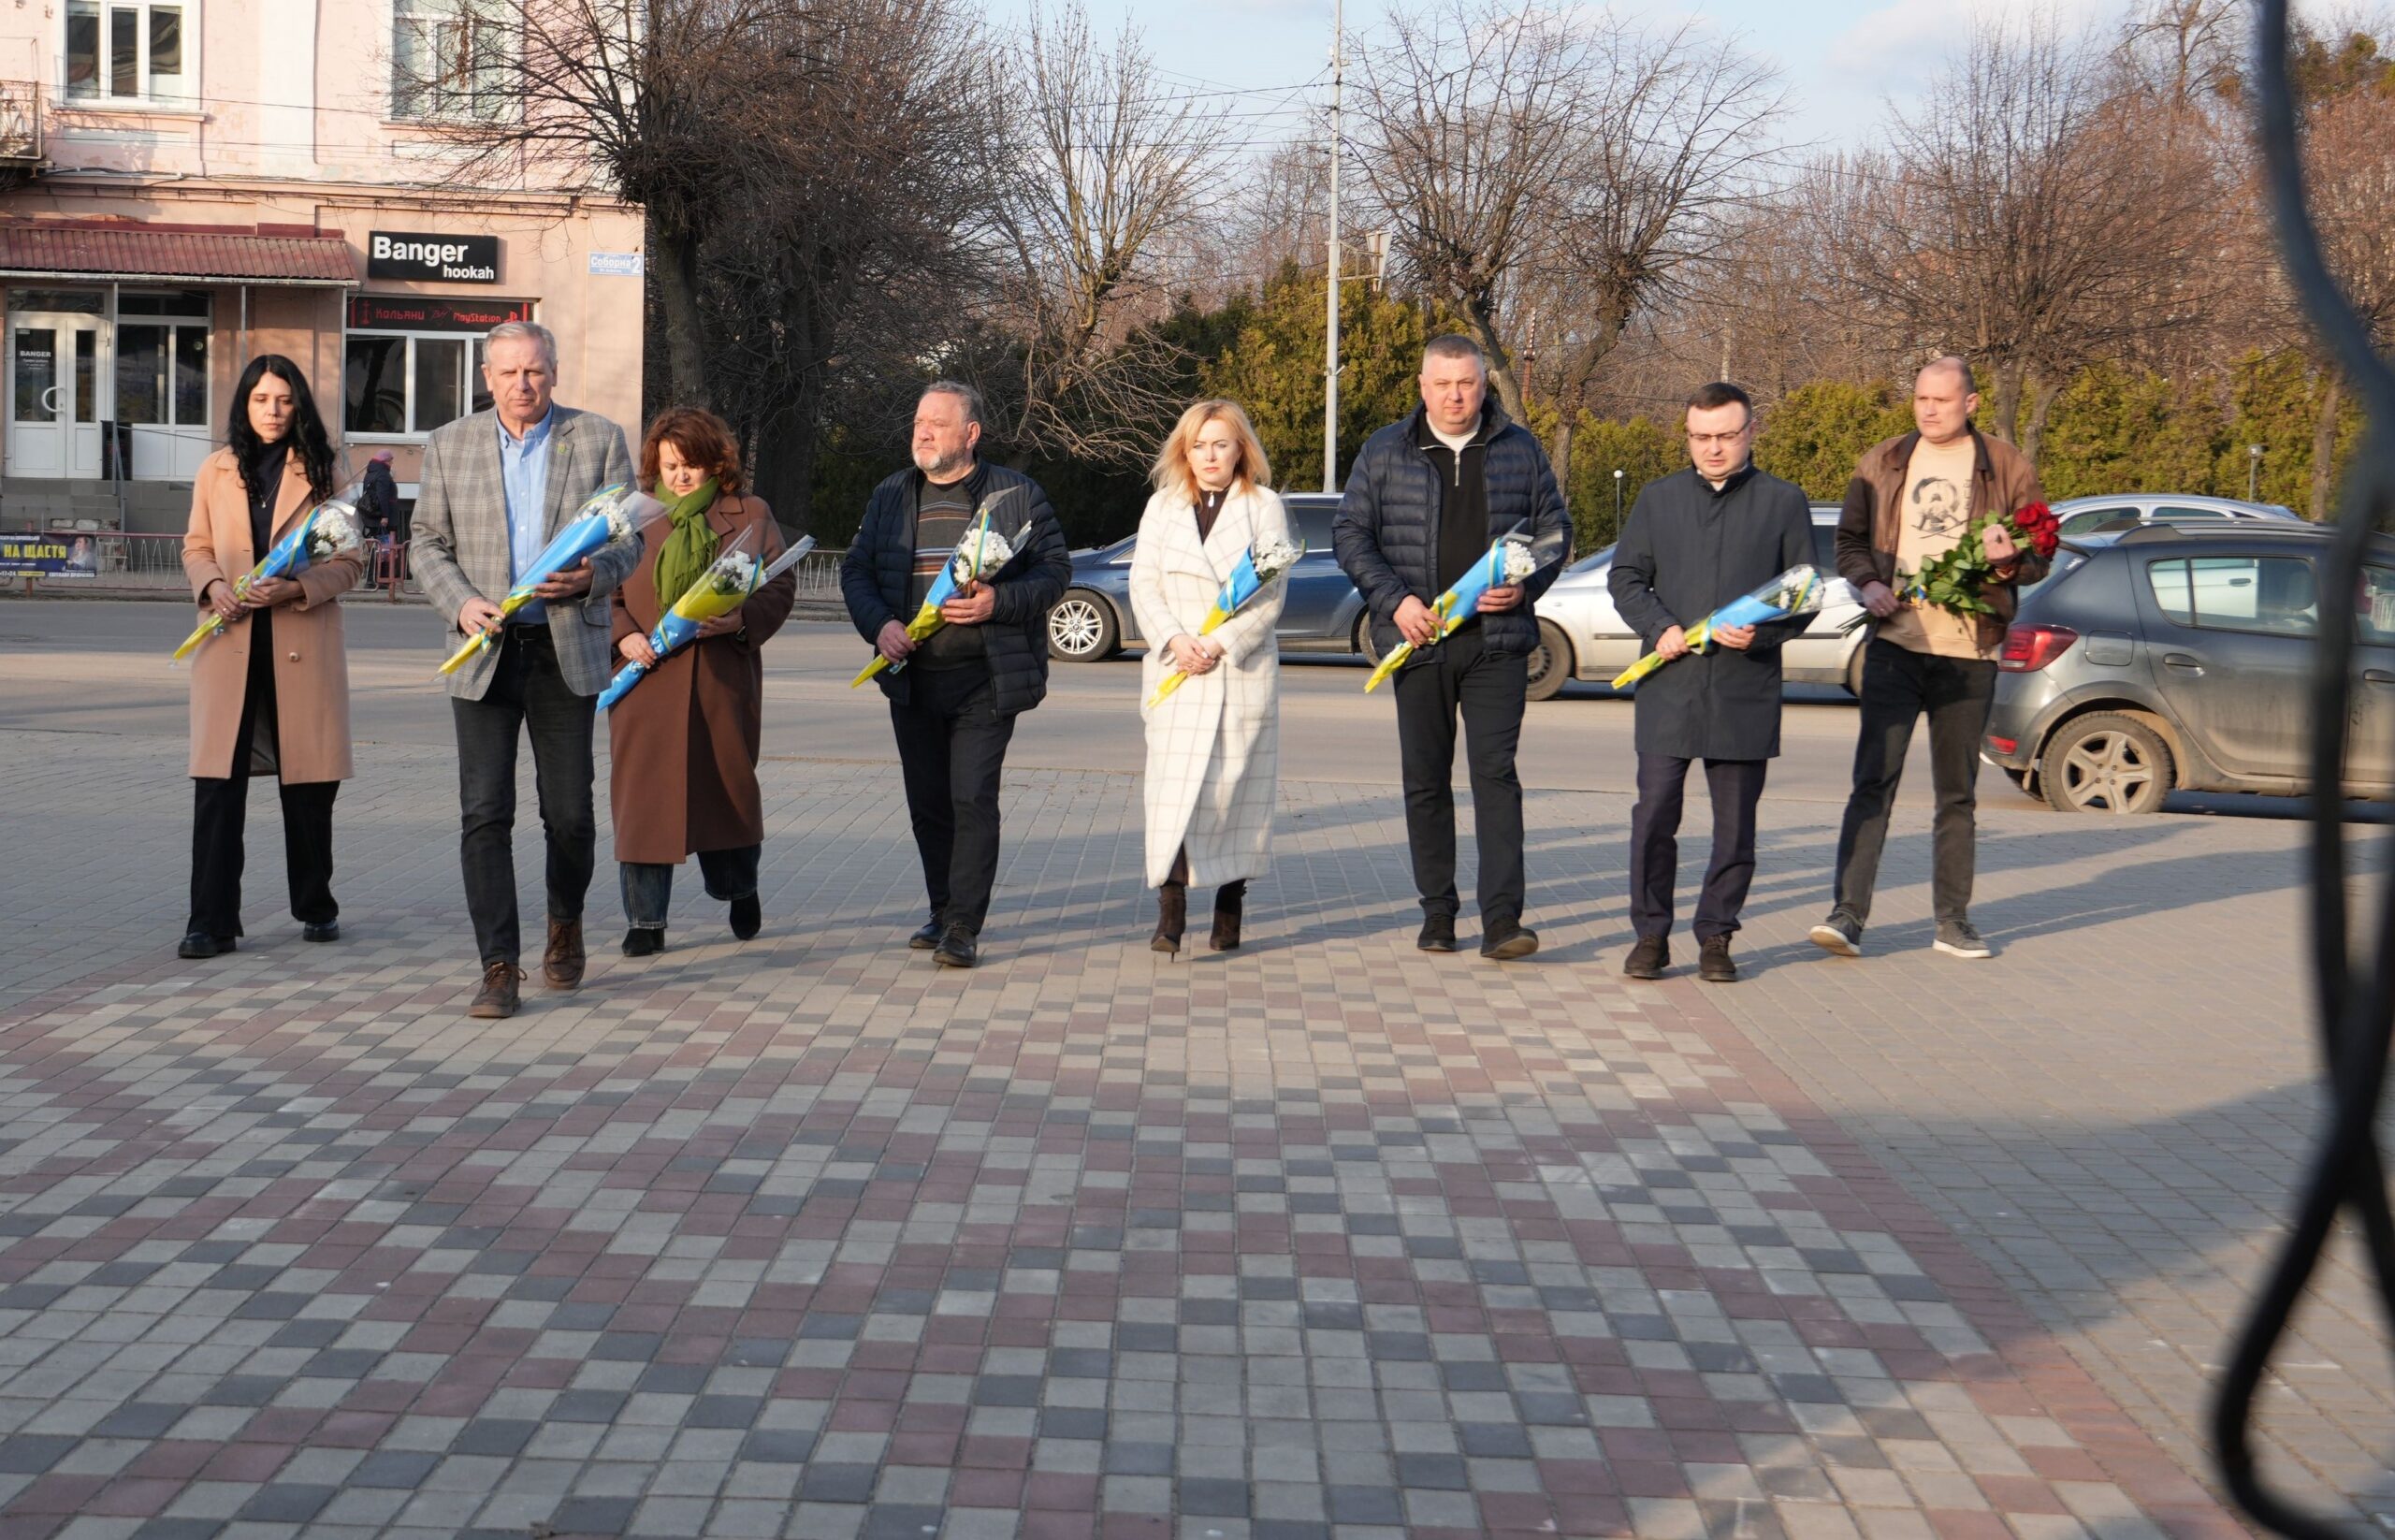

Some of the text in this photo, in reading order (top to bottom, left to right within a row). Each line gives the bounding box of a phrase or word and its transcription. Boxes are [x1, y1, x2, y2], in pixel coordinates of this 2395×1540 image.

[373, 236, 469, 267] Banger
[443, 265, 495, 280] hookah
[631, 256, 642, 274] 2
[453, 312, 501, 324] PlayStation
[4, 544, 67, 559] НА ЩАСТЯ
